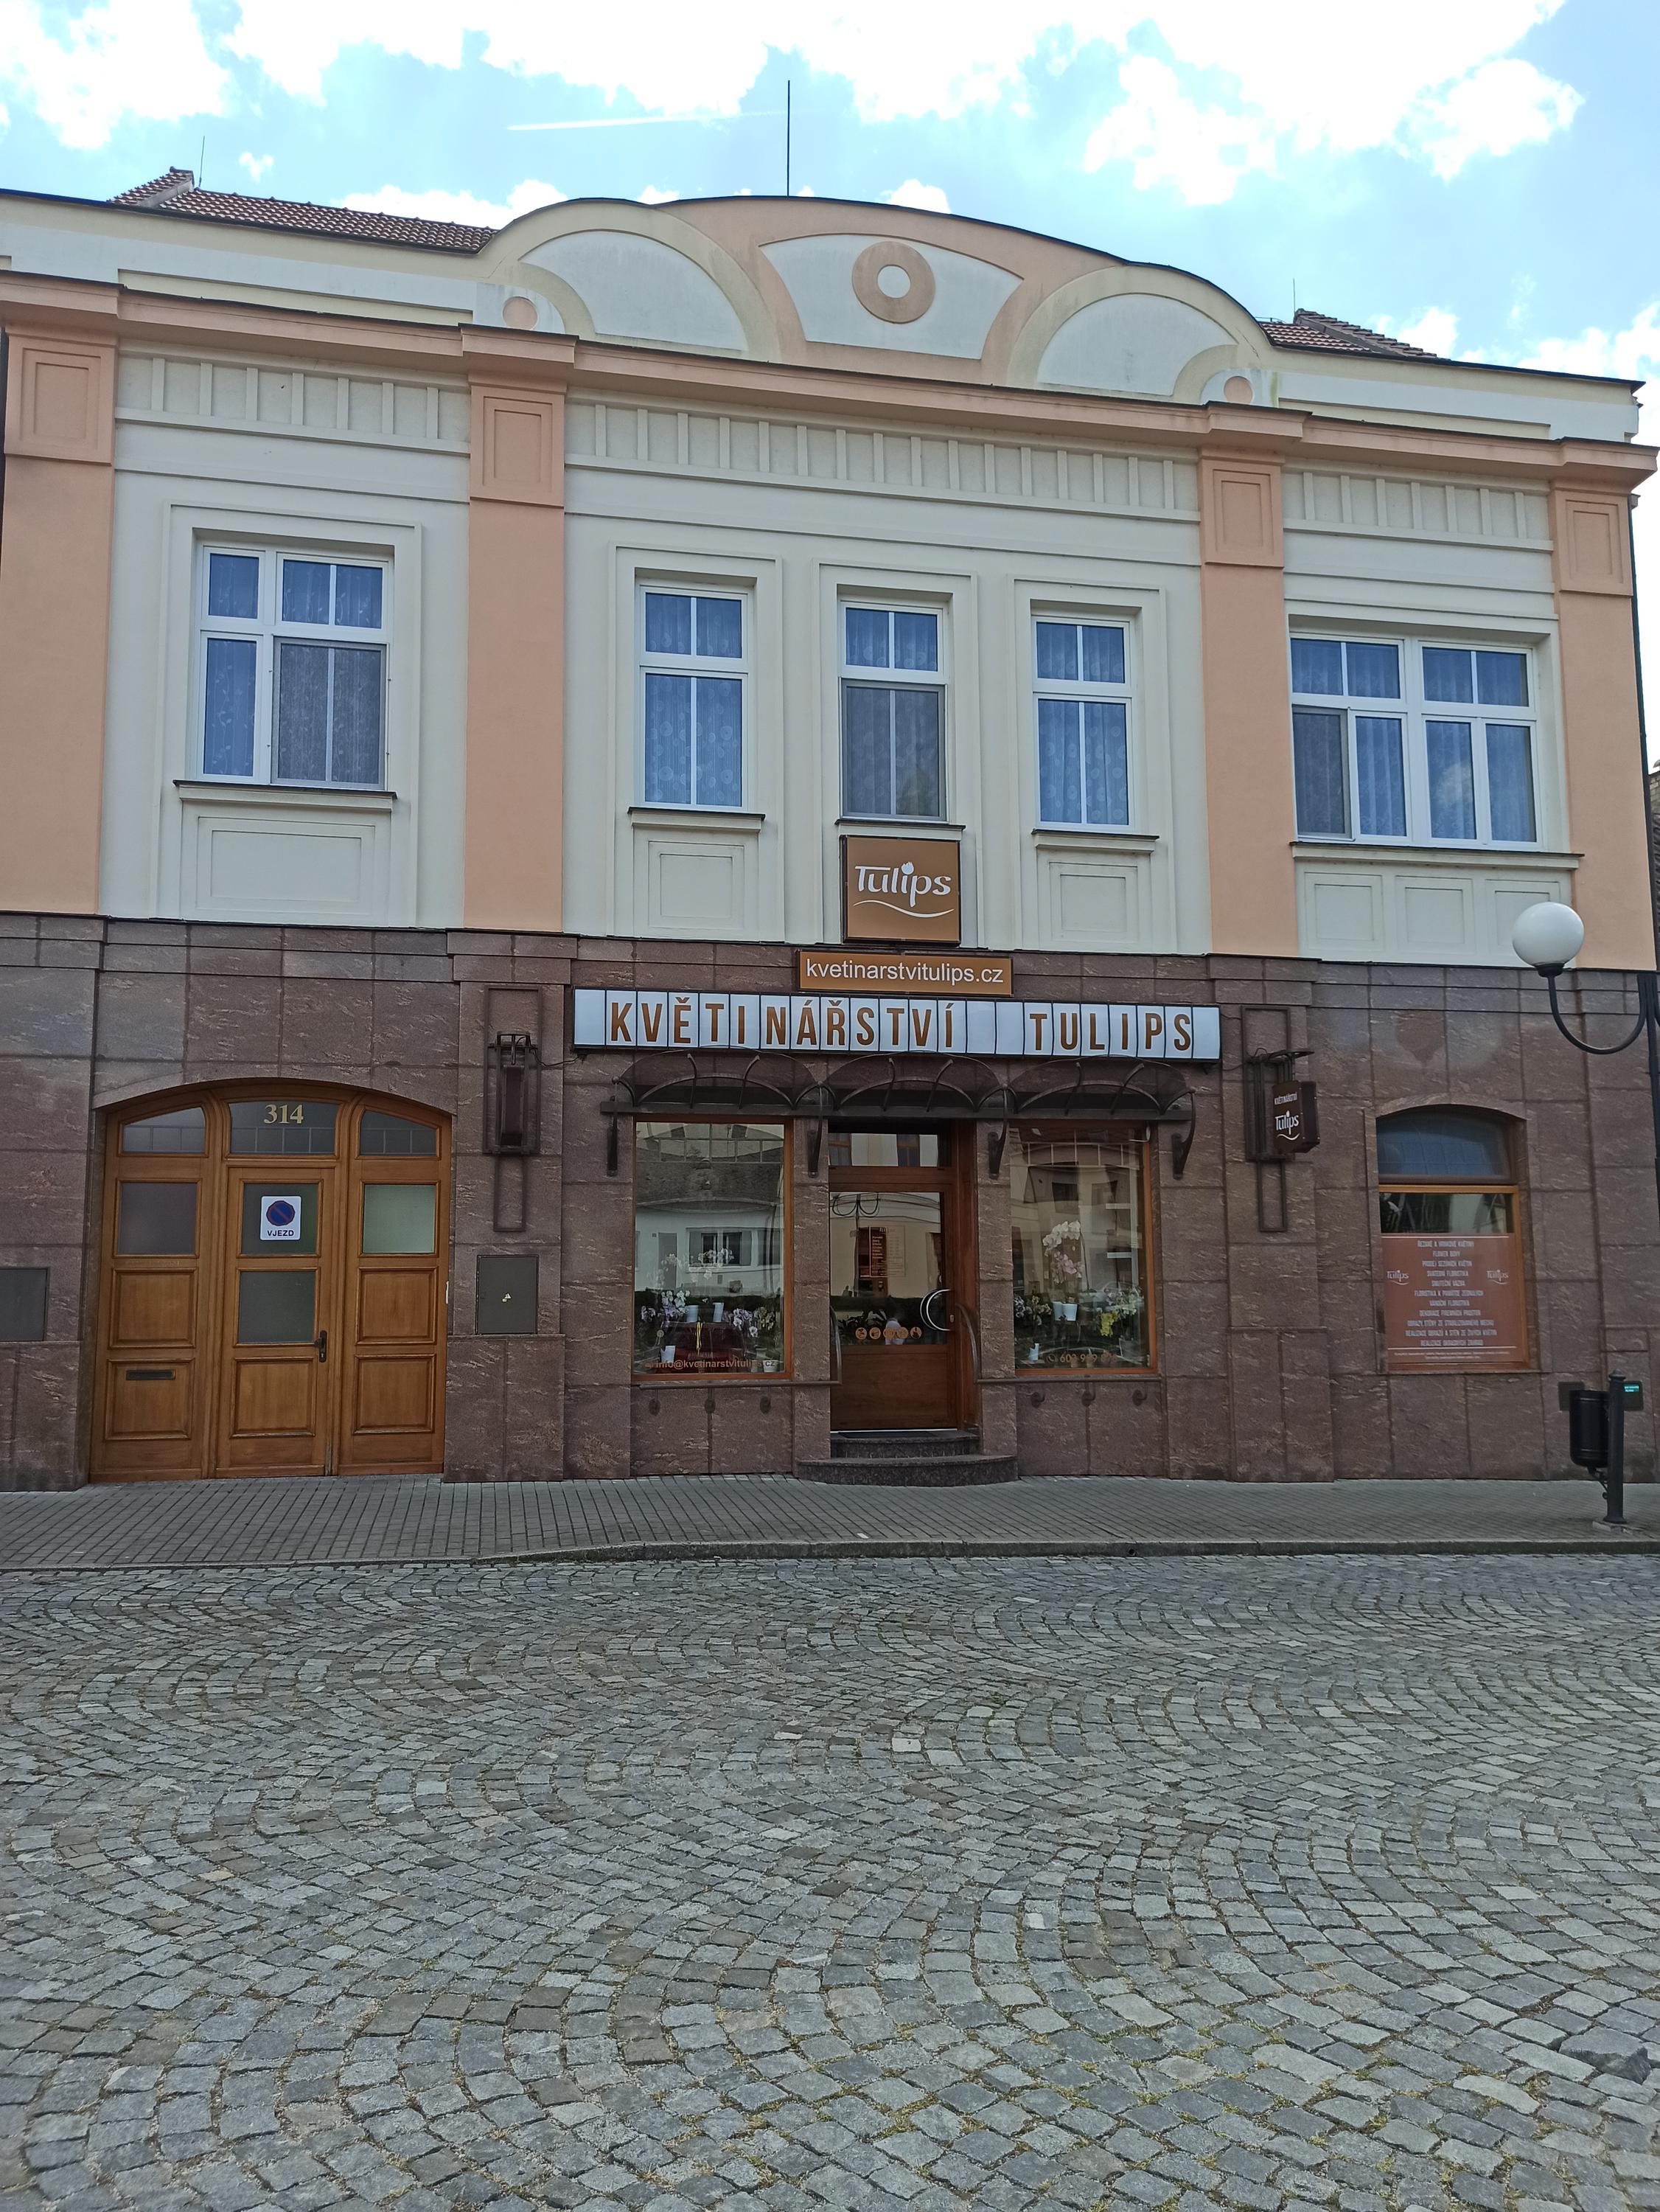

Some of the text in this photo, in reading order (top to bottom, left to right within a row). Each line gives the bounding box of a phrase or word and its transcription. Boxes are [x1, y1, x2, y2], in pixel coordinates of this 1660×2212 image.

[854, 861, 952, 908] Tulips
[806, 959, 1004, 985] kvetinarstvitulips.cz
[610, 996, 1191, 1051] KVĚTINÁŘSTVÍ TULIPS
[263, 1104, 304, 1124] 314
[1274, 1110, 1300, 1135] Tulips
[1387, 1270, 1409, 1282] Tulips
[1486, 1269, 1509, 1281] Tulips
[1080, 1354, 1098, 1363] 99
